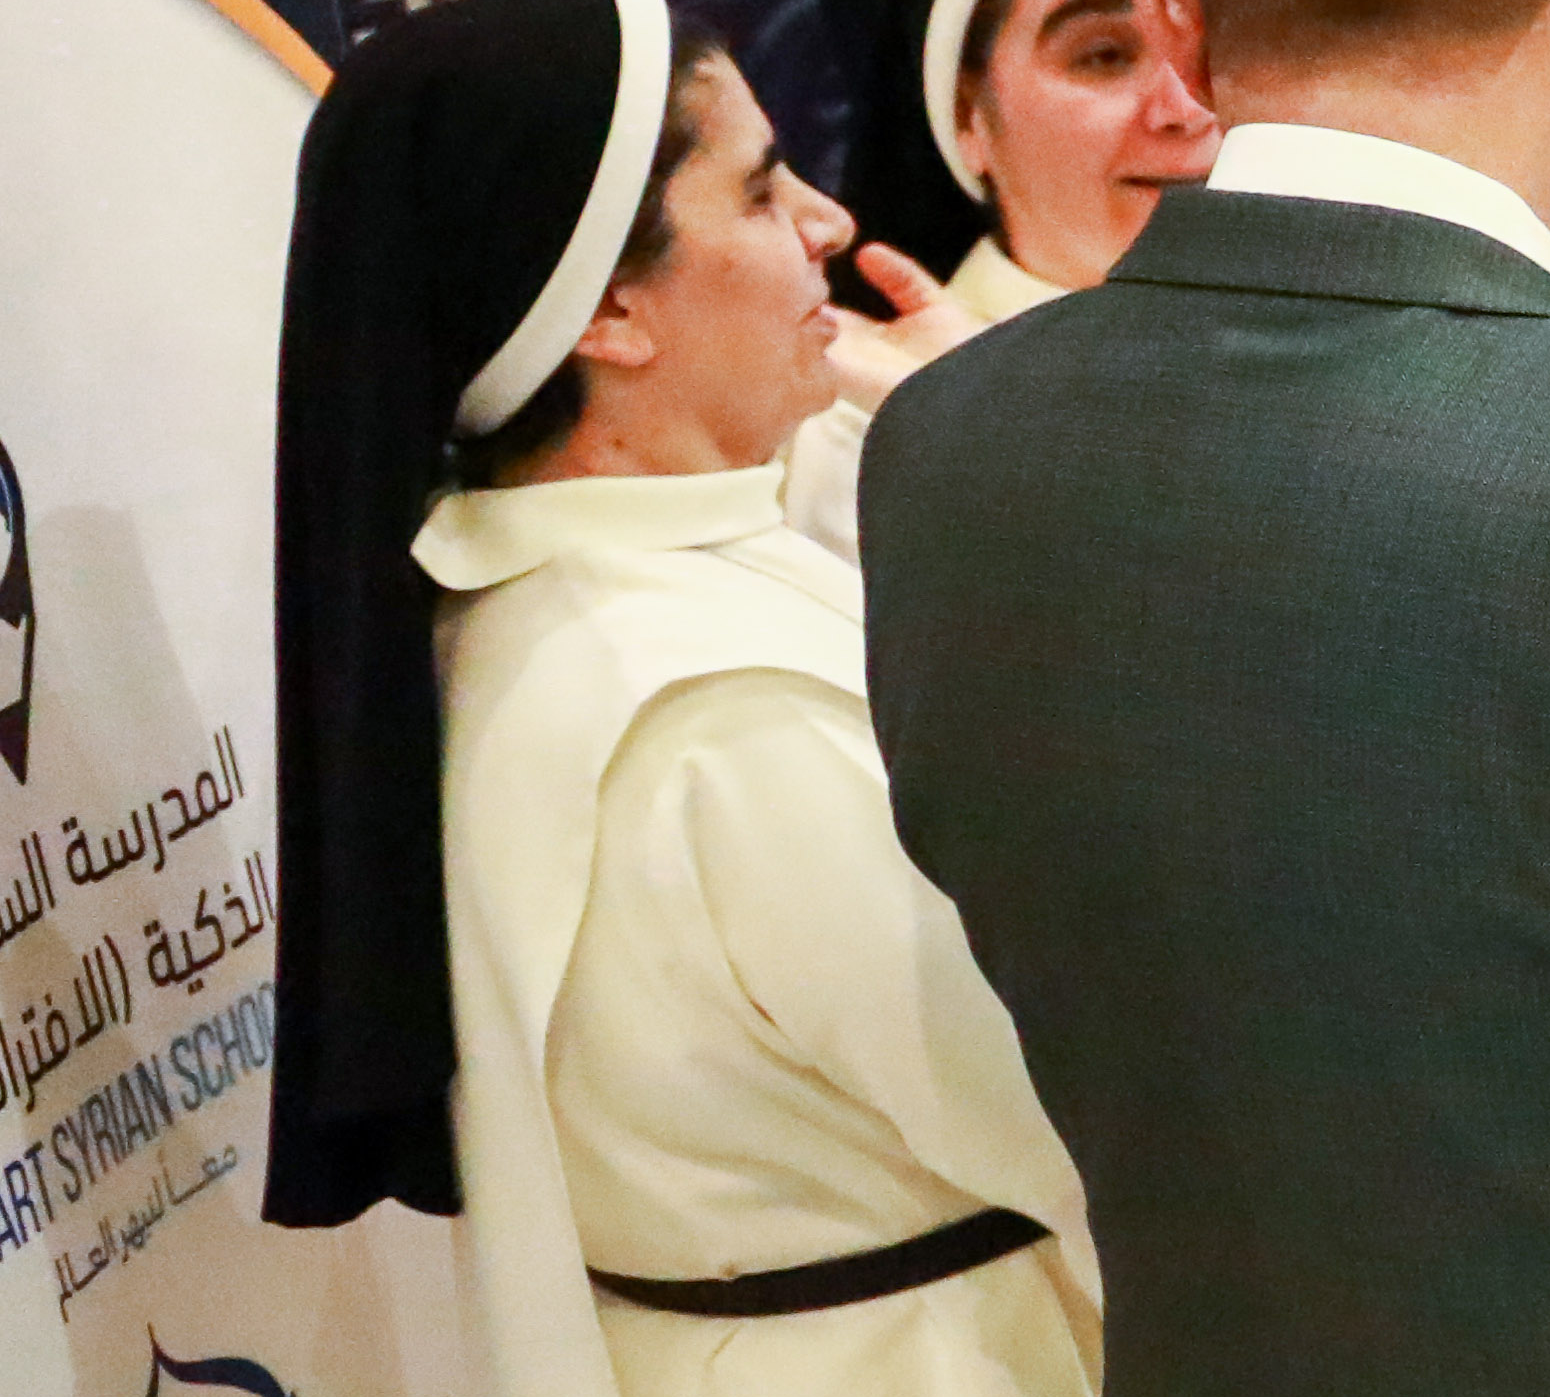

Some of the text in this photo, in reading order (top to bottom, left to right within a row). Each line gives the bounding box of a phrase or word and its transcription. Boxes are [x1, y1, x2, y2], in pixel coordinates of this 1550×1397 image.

[61, 724, 245, 886] المدرسة
[143, 850, 277, 996] الذكية
[0, 934, 132, 1113] (الافترا
[0, 981, 276, 1262] ART SYRIAN SCHOO
